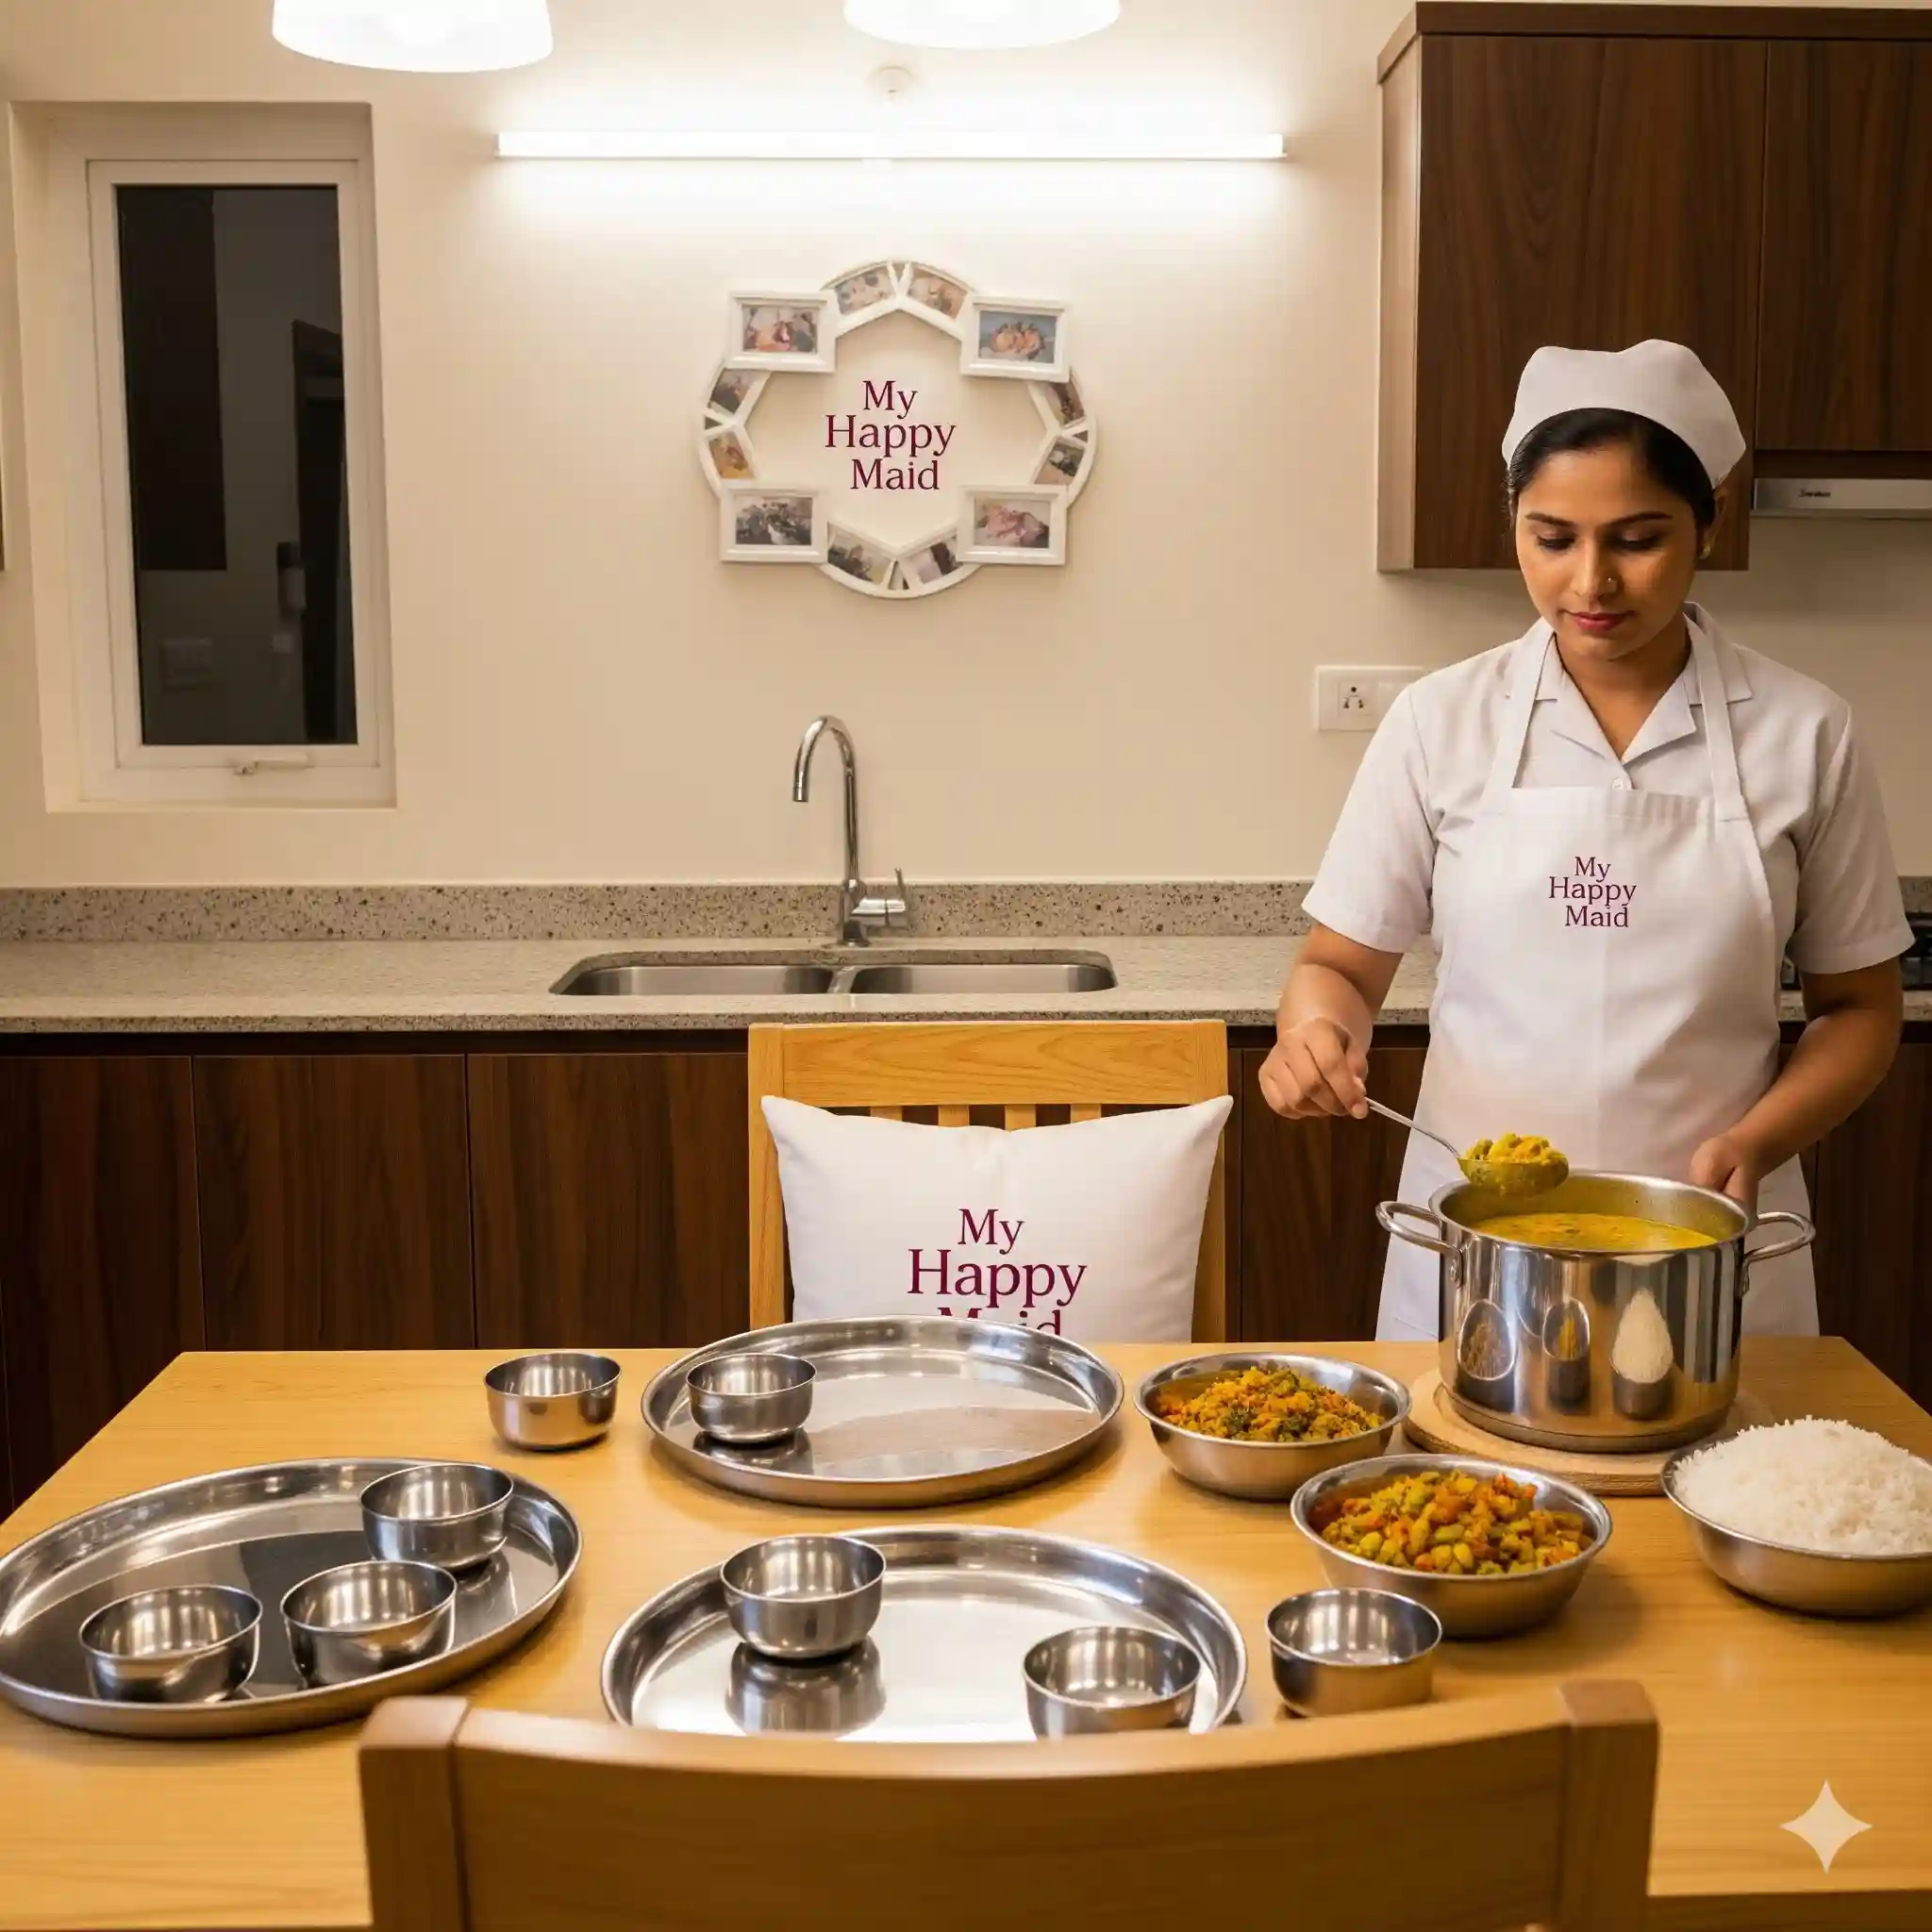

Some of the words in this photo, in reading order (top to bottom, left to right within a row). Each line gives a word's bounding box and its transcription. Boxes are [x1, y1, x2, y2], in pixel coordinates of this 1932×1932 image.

[862, 380, 918, 420] My
[824, 414, 958, 458] Happy
[850, 458, 940, 490] Maid
[1574, 857, 1611, 883] My
[1548, 876, 1637, 907] Happy
[1565, 906, 1629, 928] Maid
[958, 1208, 1024, 1256] My
[907, 1249, 1088, 1308] Happy
